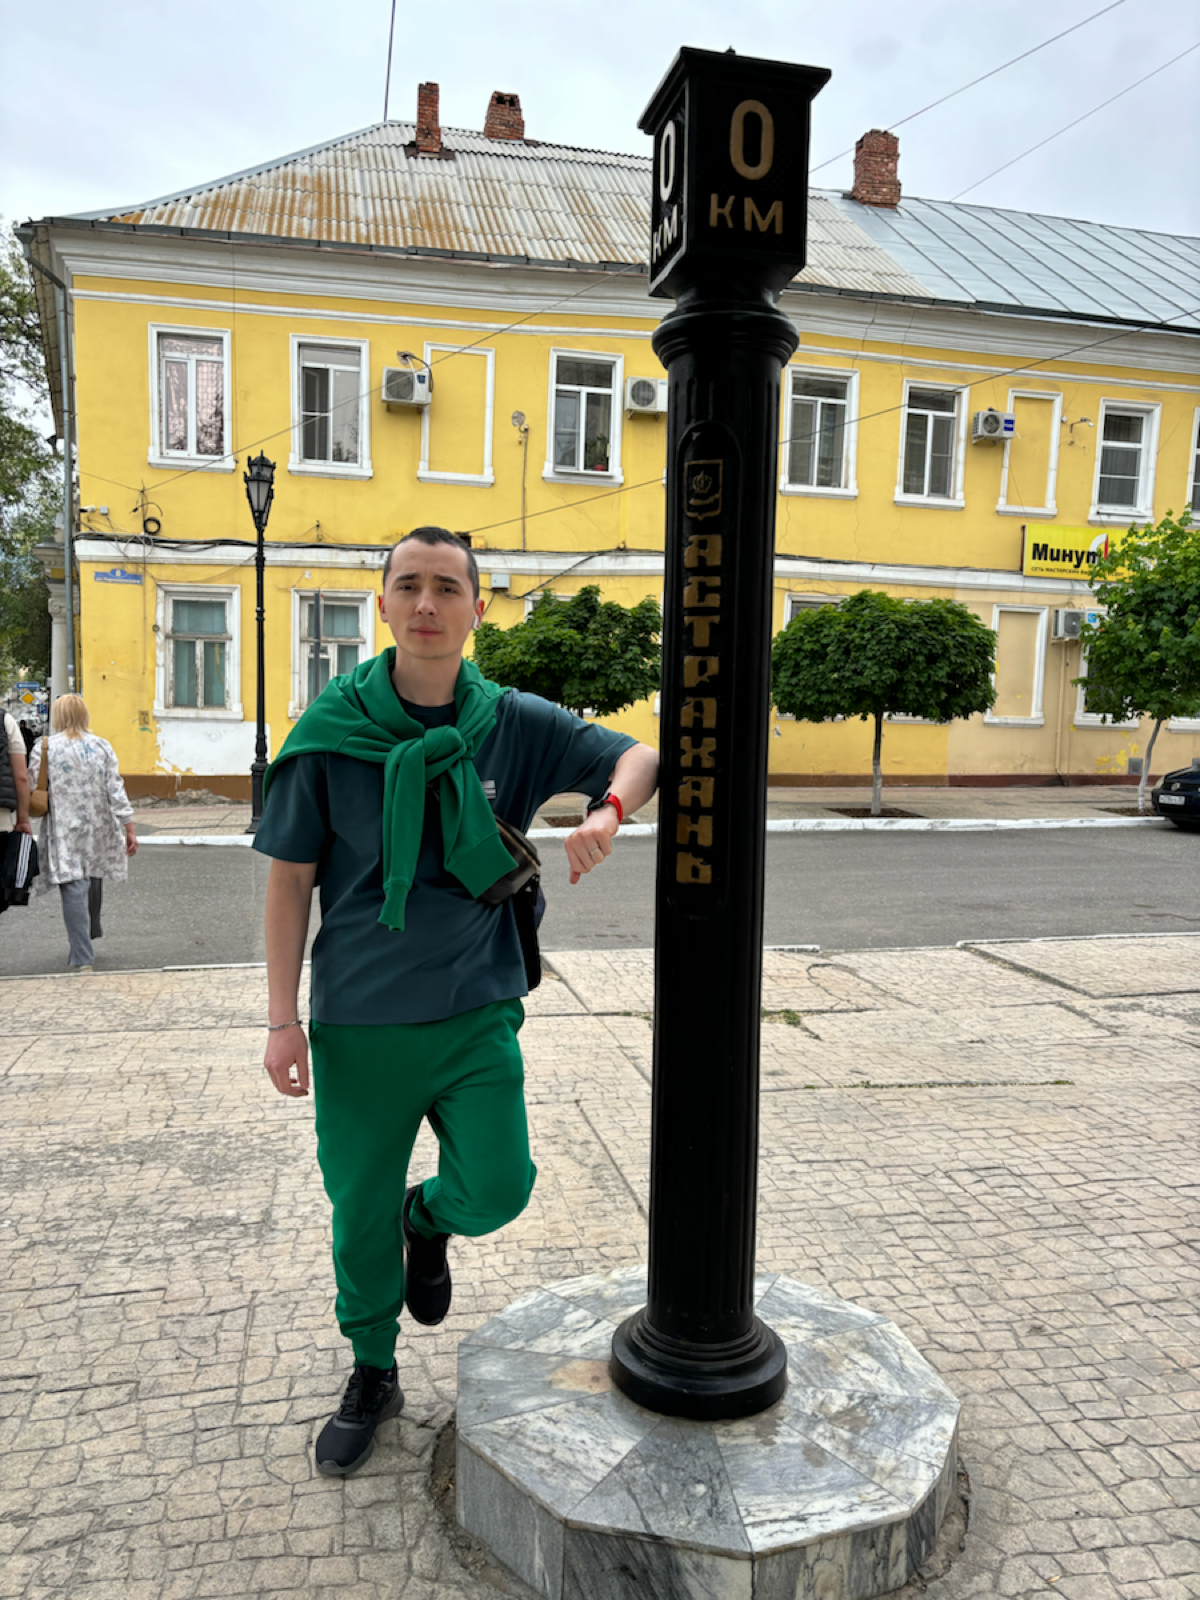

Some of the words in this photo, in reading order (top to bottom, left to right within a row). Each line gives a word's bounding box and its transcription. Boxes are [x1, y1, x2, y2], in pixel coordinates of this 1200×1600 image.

[659, 120, 676, 202] 0
[728, 99, 775, 181] 0
[675, 534, 723, 884] АСТРАХАНЬ
